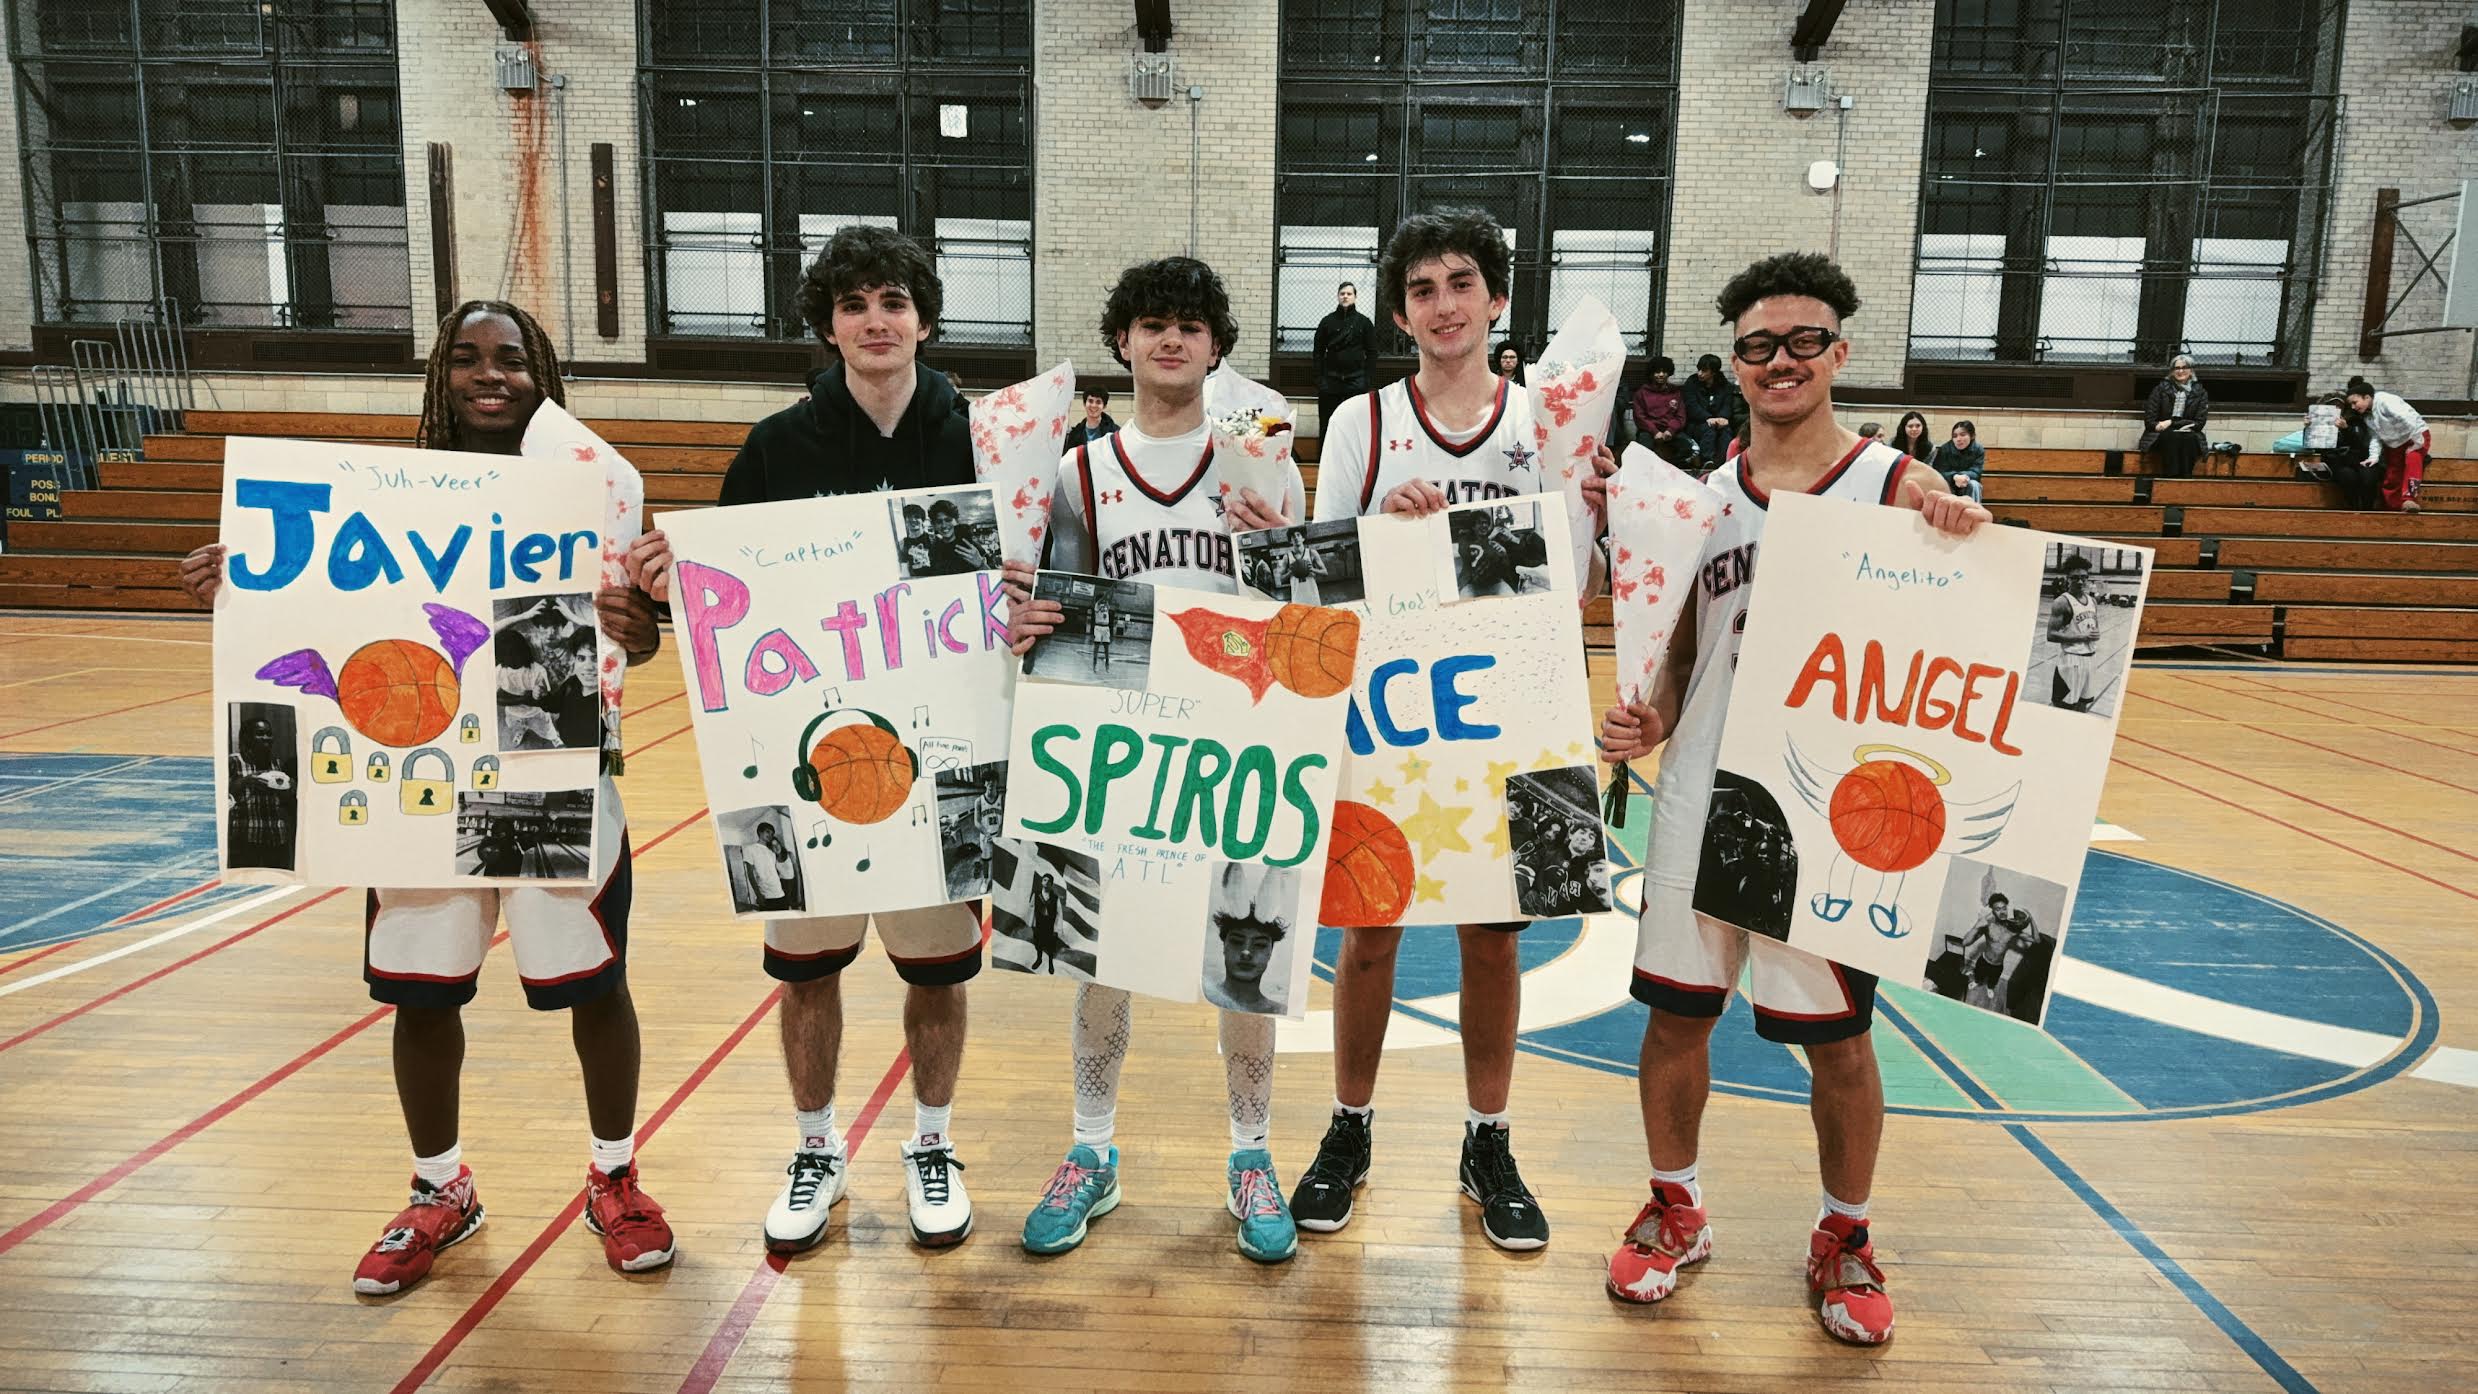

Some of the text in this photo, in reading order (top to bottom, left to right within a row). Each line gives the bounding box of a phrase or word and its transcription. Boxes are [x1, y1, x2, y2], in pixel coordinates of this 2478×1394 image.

[6, 508, 33, 517] FOUL
[228, 478, 598, 592] Javier
[738, 530, 863, 567] "Captain"
[1841, 551, 1964, 591] "Angelito"
[1784, 632, 2023, 756] ANGEL
[1020, 723, 1328, 868] SPIROS
[1117, 843, 1147, 855] FRESH
[1156, 848, 1188, 861] PRINCE
[1194, 853, 1207, 863] OF
